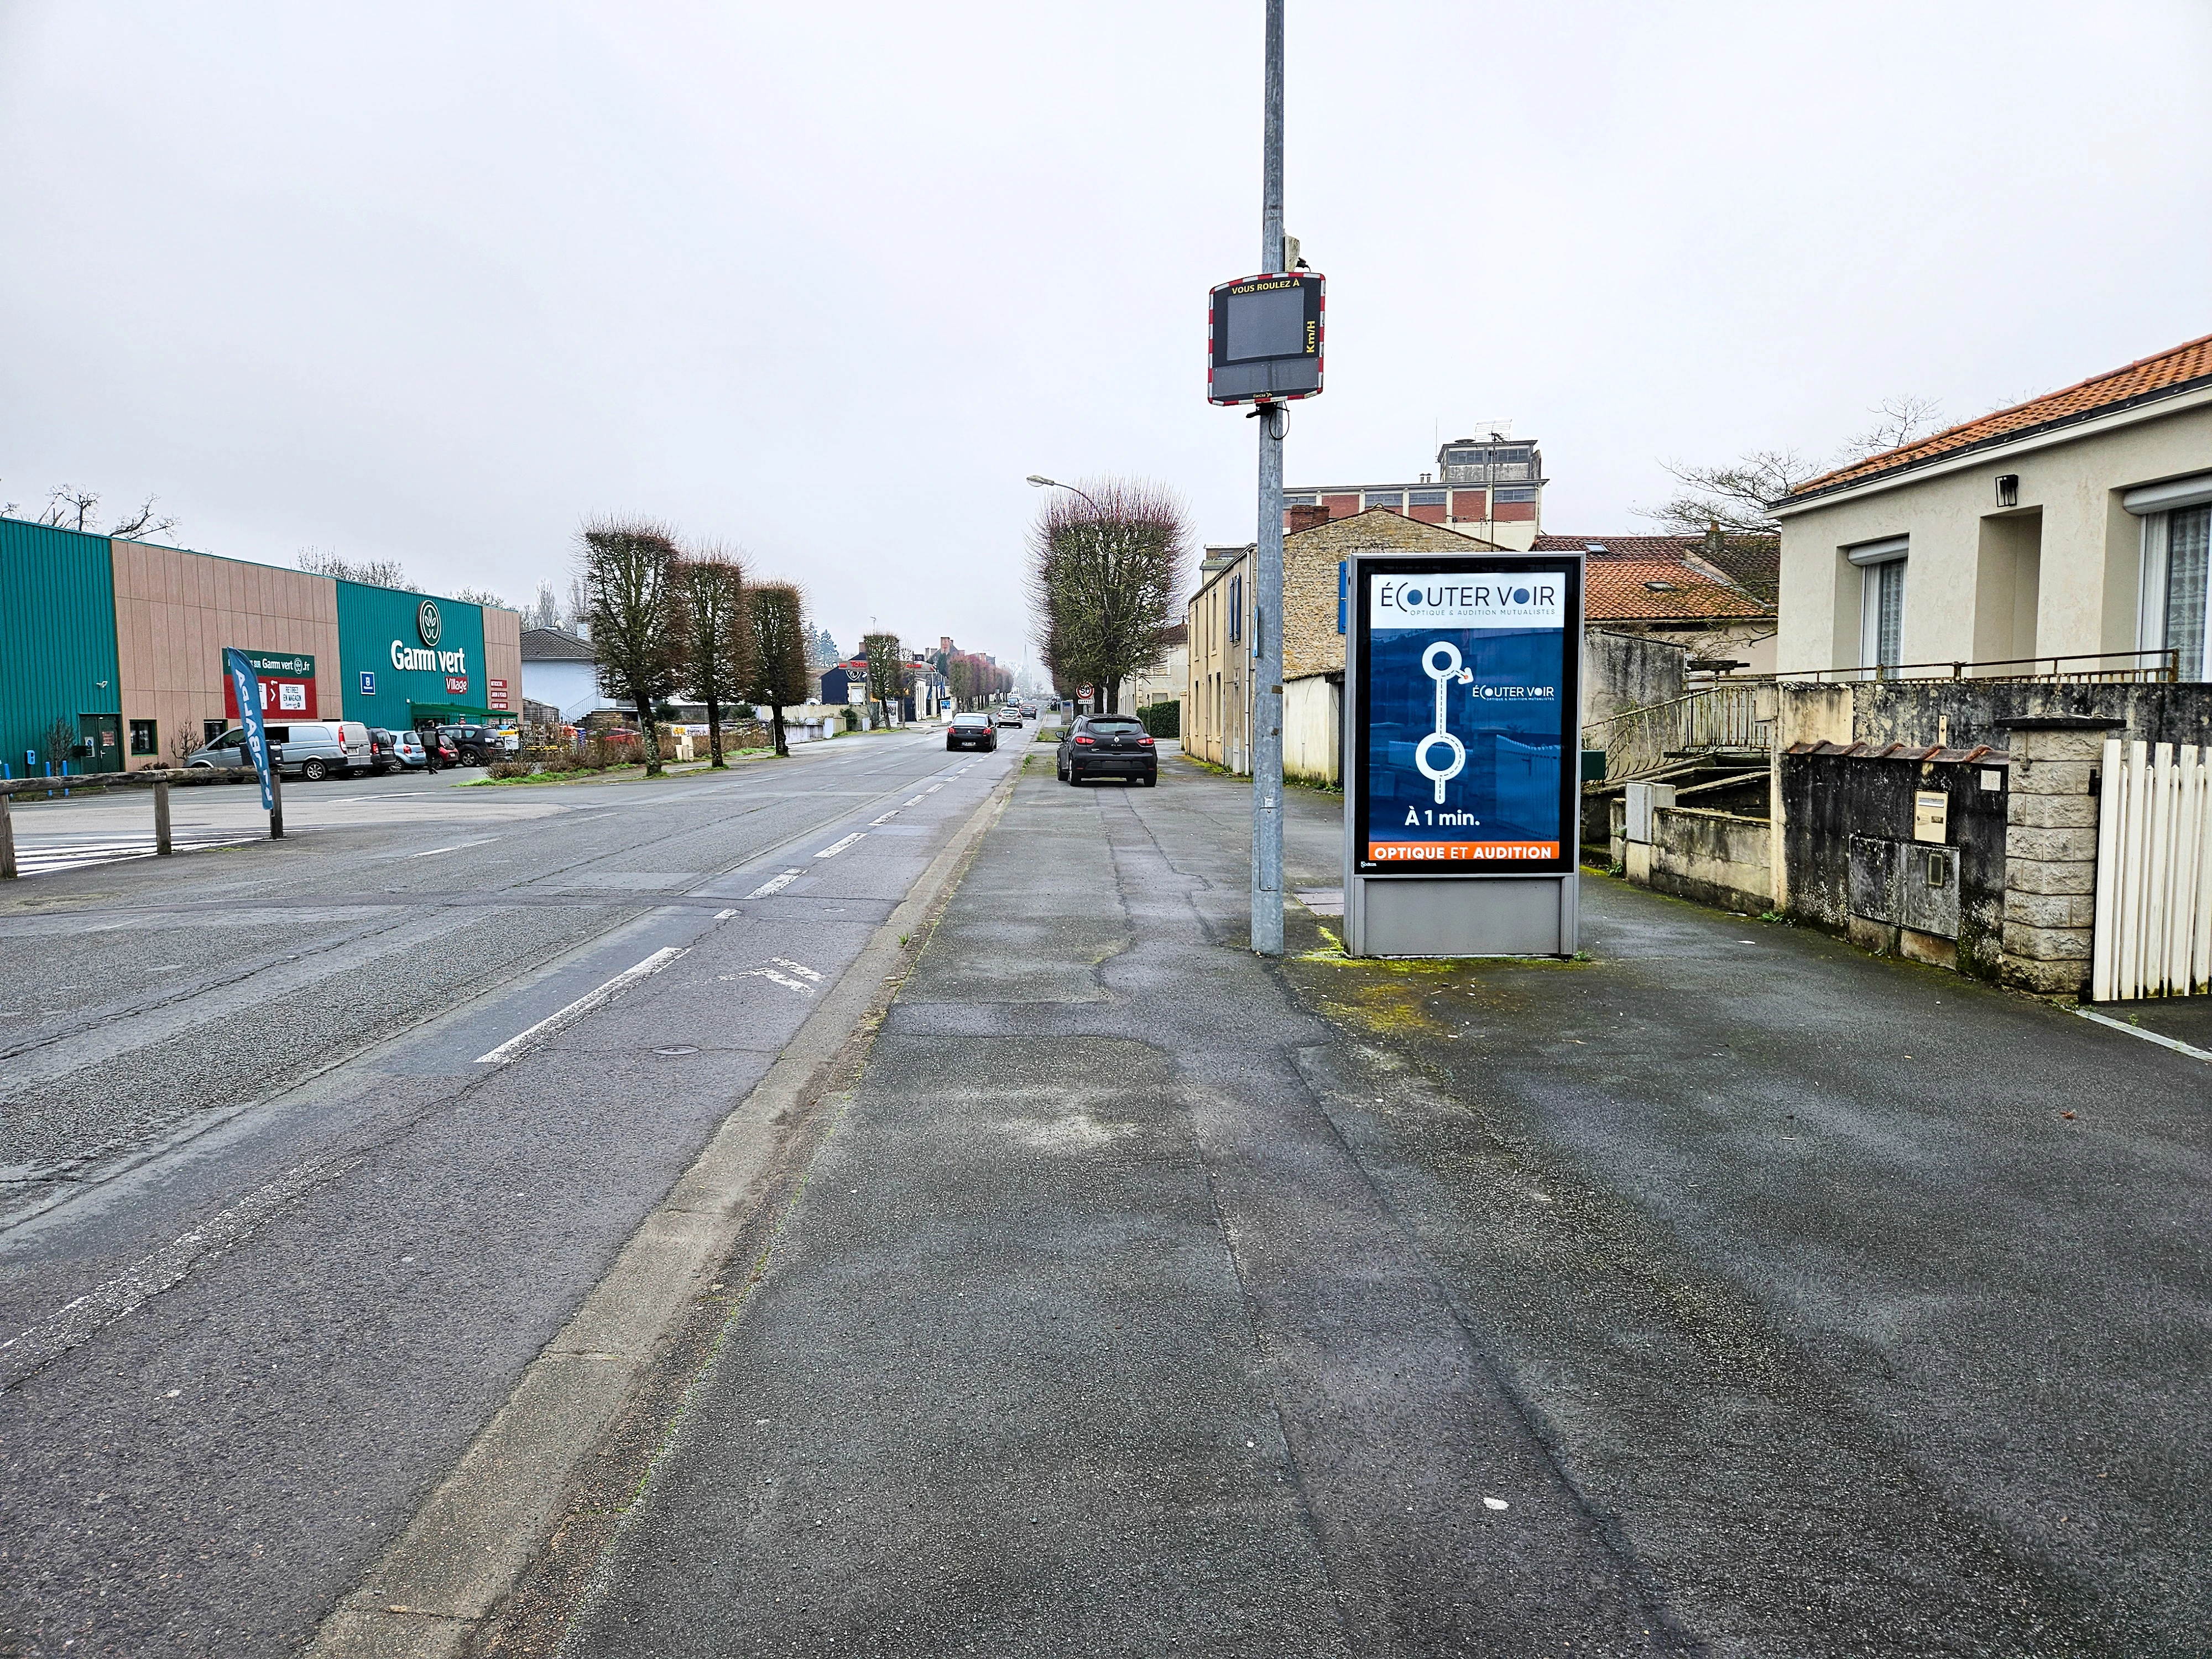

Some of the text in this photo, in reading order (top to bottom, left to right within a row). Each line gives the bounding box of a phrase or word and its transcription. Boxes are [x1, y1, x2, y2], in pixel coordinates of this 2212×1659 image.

[1232, 278, 1300, 294] VOUS ROULEZ À
[1306, 321, 1315, 353] Km/H
[1381, 582, 1554, 612] ÉCOUTER VOIR
[262, 658, 280, 670] Gamm
[281, 661, 293, 670] vert
[391, 640, 466, 674] Gamm vert
[446, 677, 467, 692] Village
[1473, 685, 1554, 700] ÉCOUTER VOIR
[1405, 806, 1480, 826] À 1 min.
[1374, 847, 1551, 859] OPTIQUE ET AUDITION
